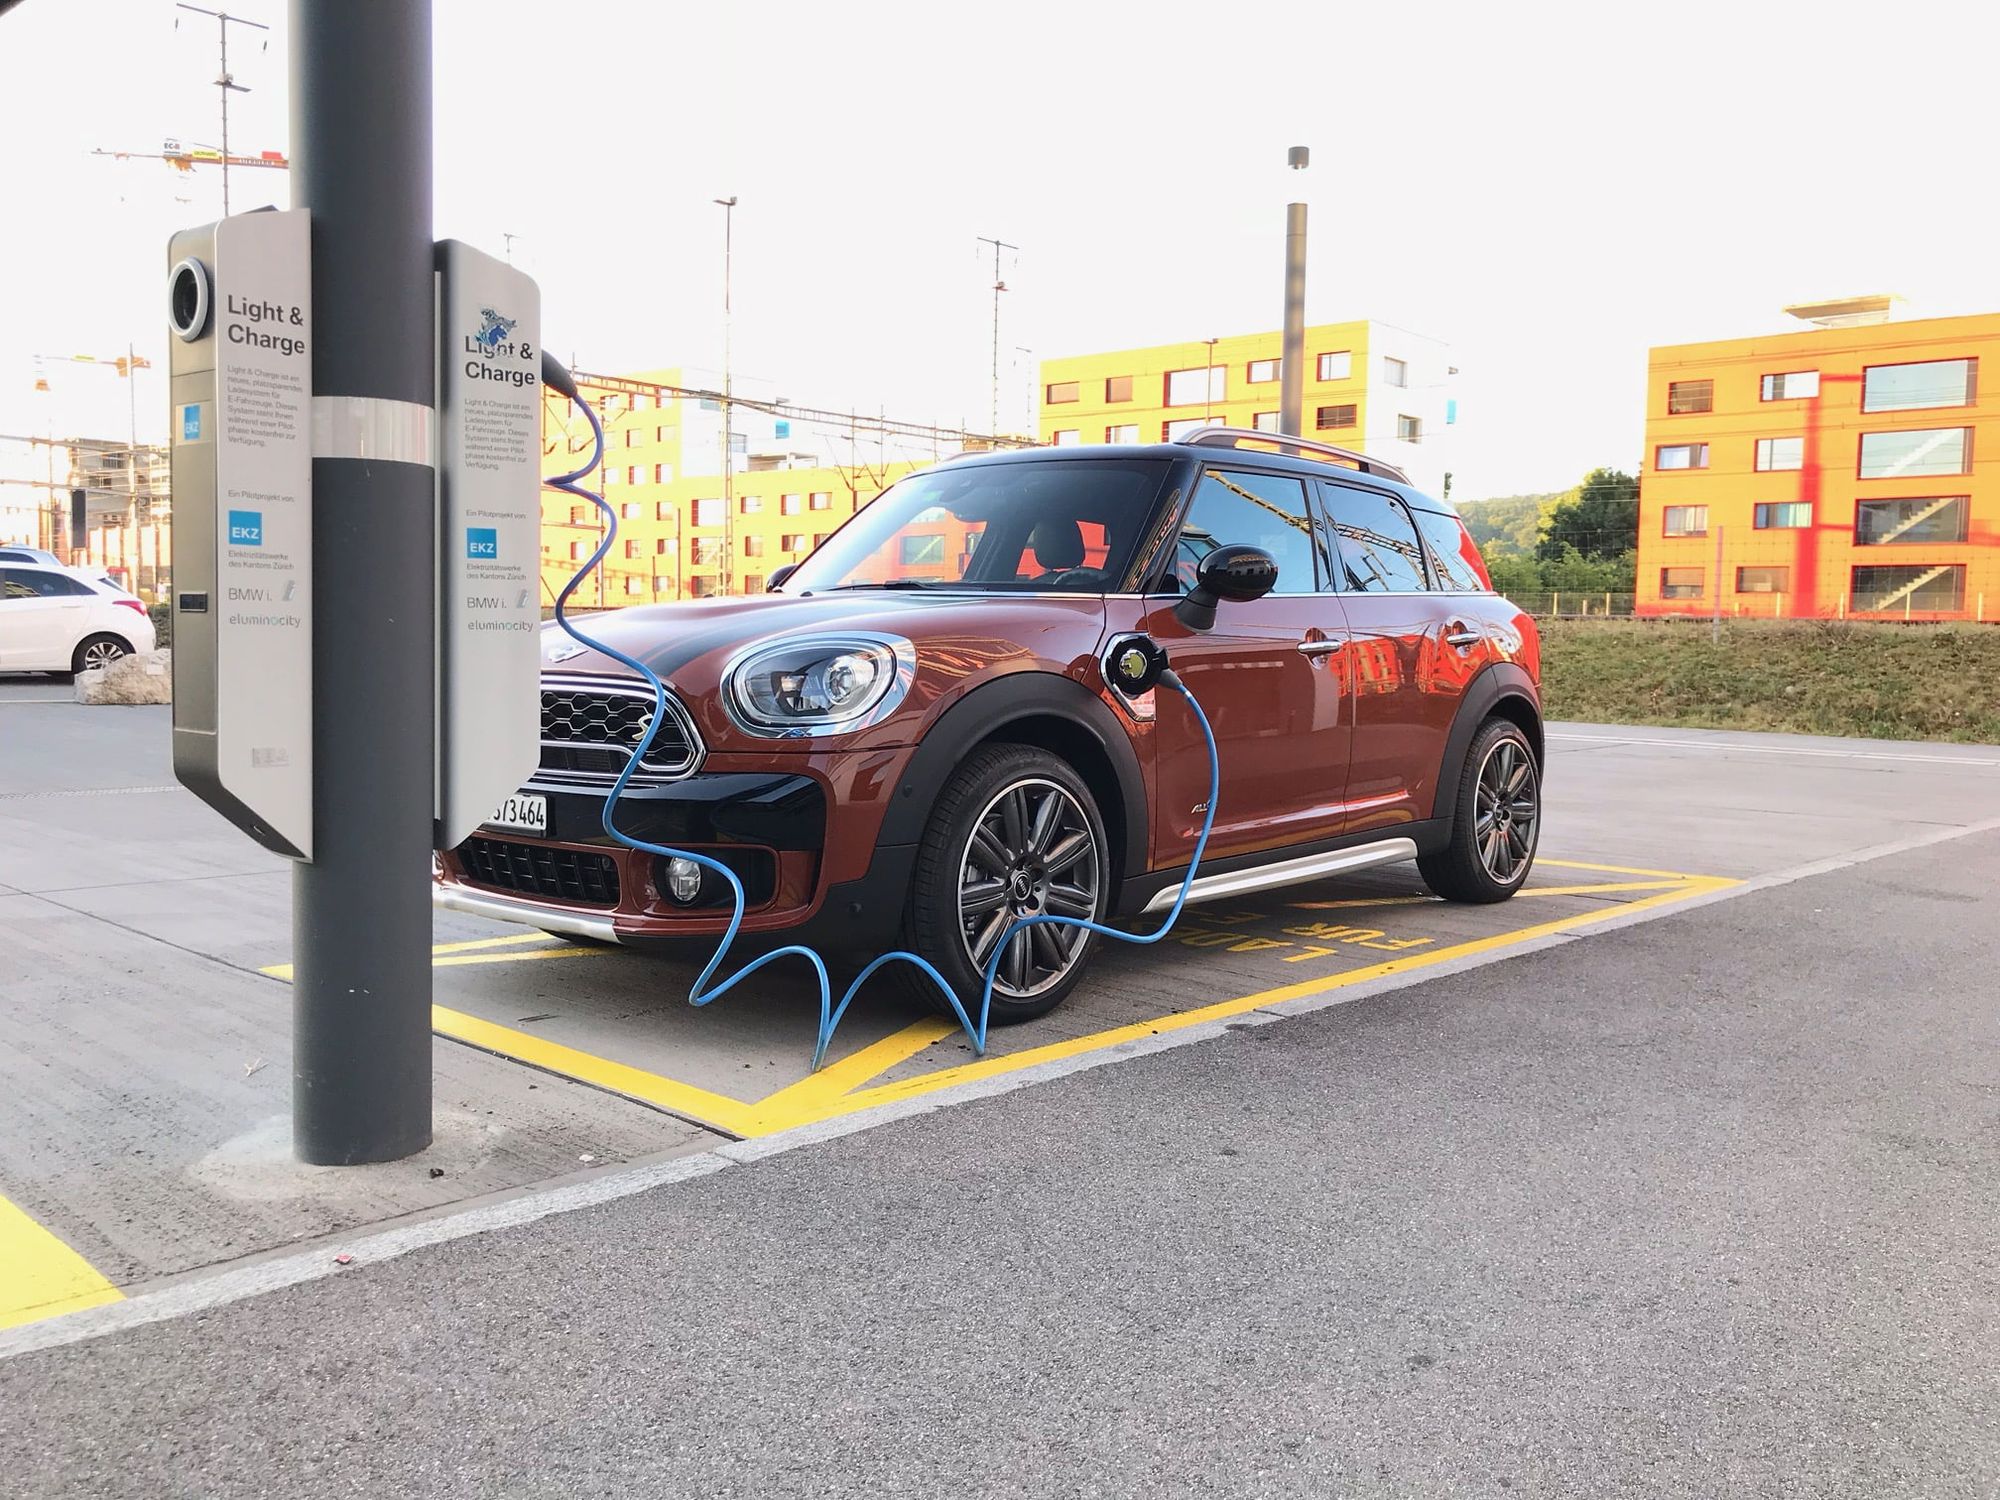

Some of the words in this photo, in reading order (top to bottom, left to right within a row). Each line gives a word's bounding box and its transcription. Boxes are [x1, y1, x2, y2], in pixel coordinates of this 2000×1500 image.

[228, 294, 284, 323] Light
[290, 306, 304, 326] &
[228, 324, 305, 356] Charge
[520, 342, 533, 360] &
[465, 361, 535, 387] Charge
[241, 490, 280, 501] Pilotprojekt
[478, 510, 513, 519] Pilotprojekt
[232, 527, 259, 539] EKZ
[470, 543, 494, 553] EKZ
[243, 561, 272, 569] Kantons
[273, 561, 294, 569] Zürich
[229, 587, 263, 601] BMW
[467, 597, 499, 608] BMW
[229, 613, 301, 628] eluminocity
[468, 620, 533, 632] eluminocity
[493, 798, 545, 827] 3464
